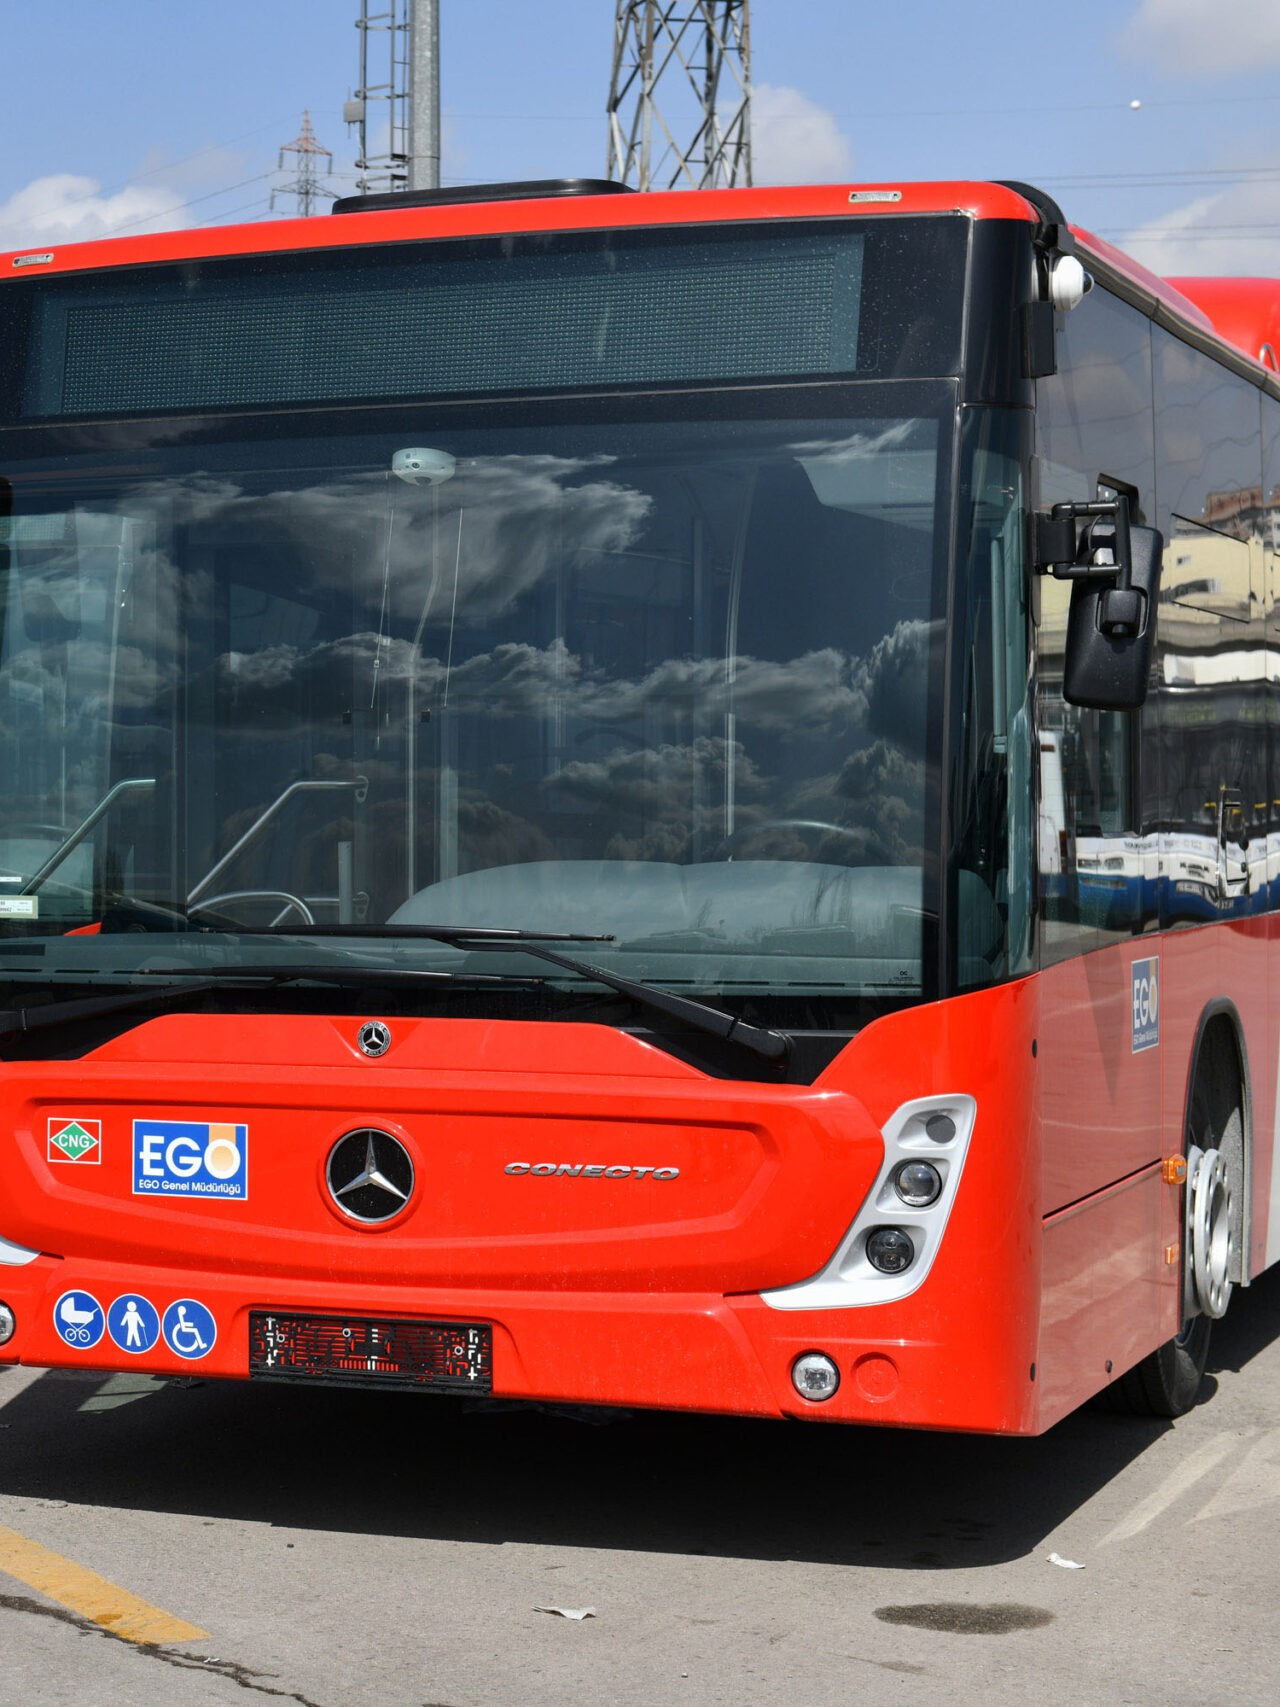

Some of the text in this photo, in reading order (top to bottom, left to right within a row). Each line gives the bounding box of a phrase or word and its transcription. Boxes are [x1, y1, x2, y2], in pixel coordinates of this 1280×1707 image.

[1133, 975, 1158, 1029] EGO
[58, 1133, 90, 1149] CNG
[139, 1135, 241, 1179] EGO
[504, 1162, 680, 1181] CONECTO
[139, 1179, 241, 1196] EGO Genel Müdürlüğü
